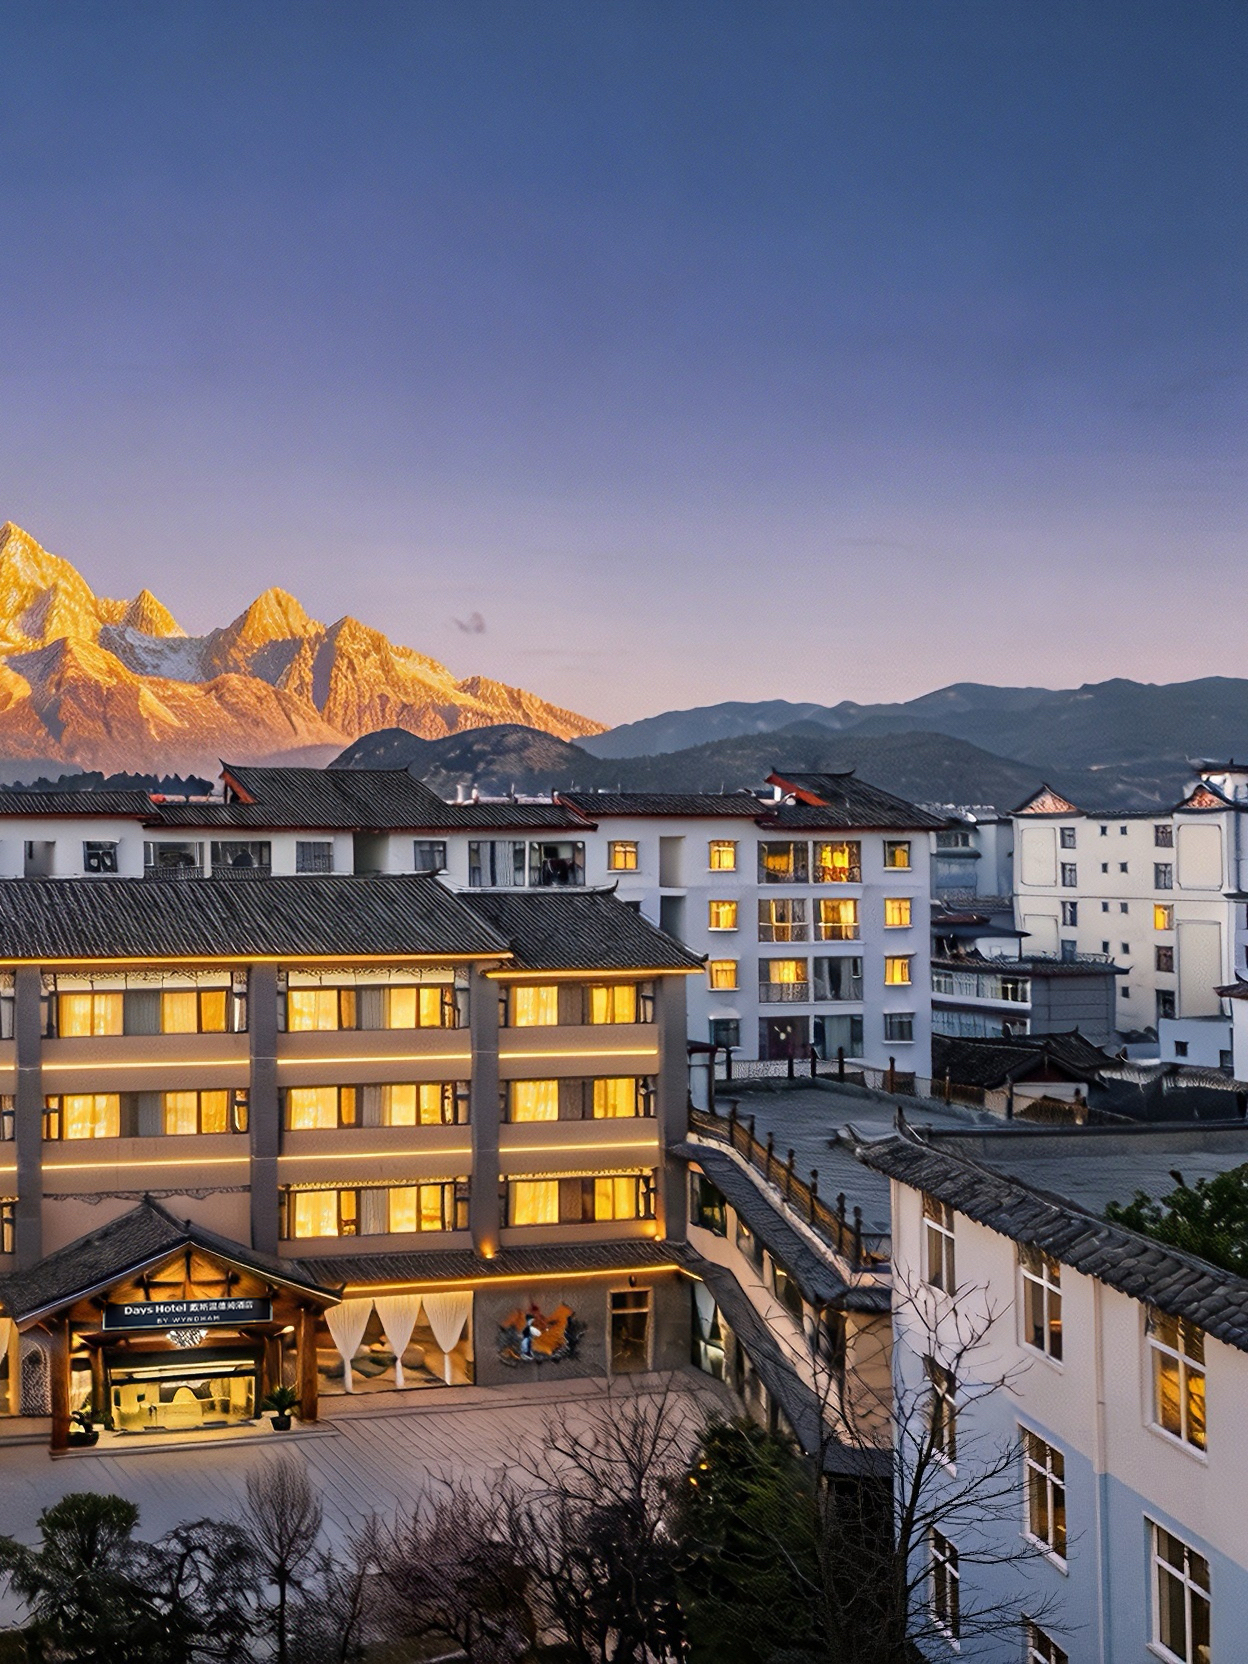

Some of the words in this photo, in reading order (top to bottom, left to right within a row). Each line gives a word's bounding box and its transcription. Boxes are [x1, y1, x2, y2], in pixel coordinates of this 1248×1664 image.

[124, 1304, 153, 1316] Days
[155, 1303, 187, 1314] Hotel
[156, 1317, 169, 1325] BY
